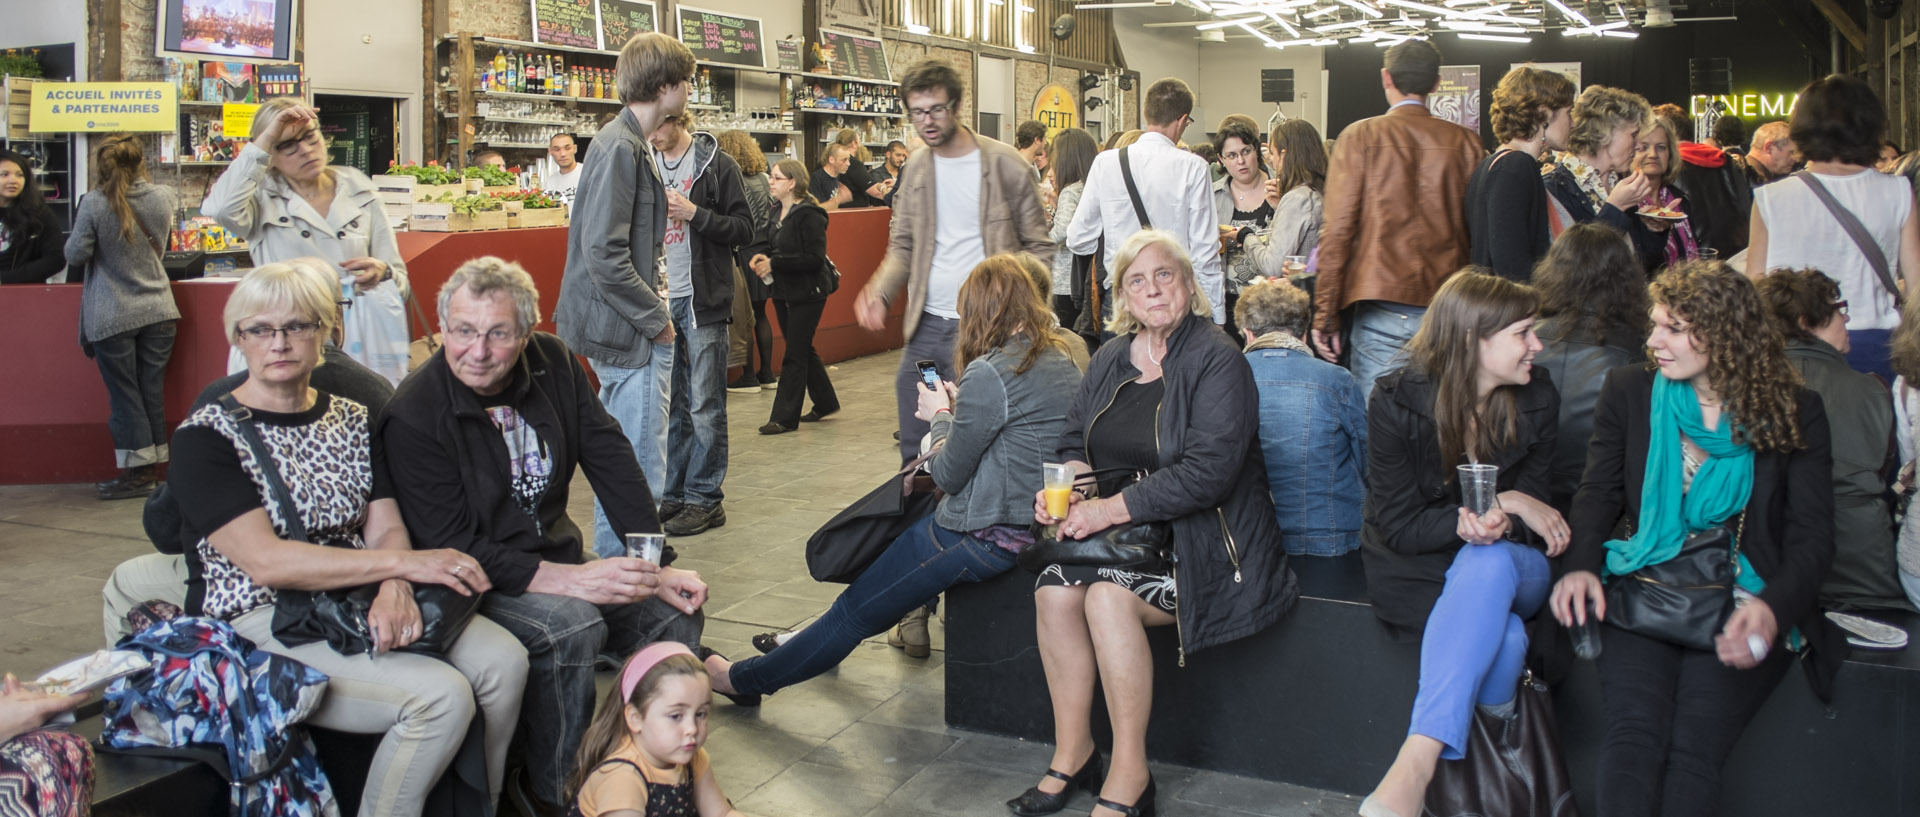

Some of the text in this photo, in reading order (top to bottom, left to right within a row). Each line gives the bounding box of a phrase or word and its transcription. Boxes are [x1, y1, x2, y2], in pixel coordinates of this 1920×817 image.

[46, 88, 162, 100] ACCUEIL INVITÉS
[52, 104, 160, 114] & PARTENAIRES
